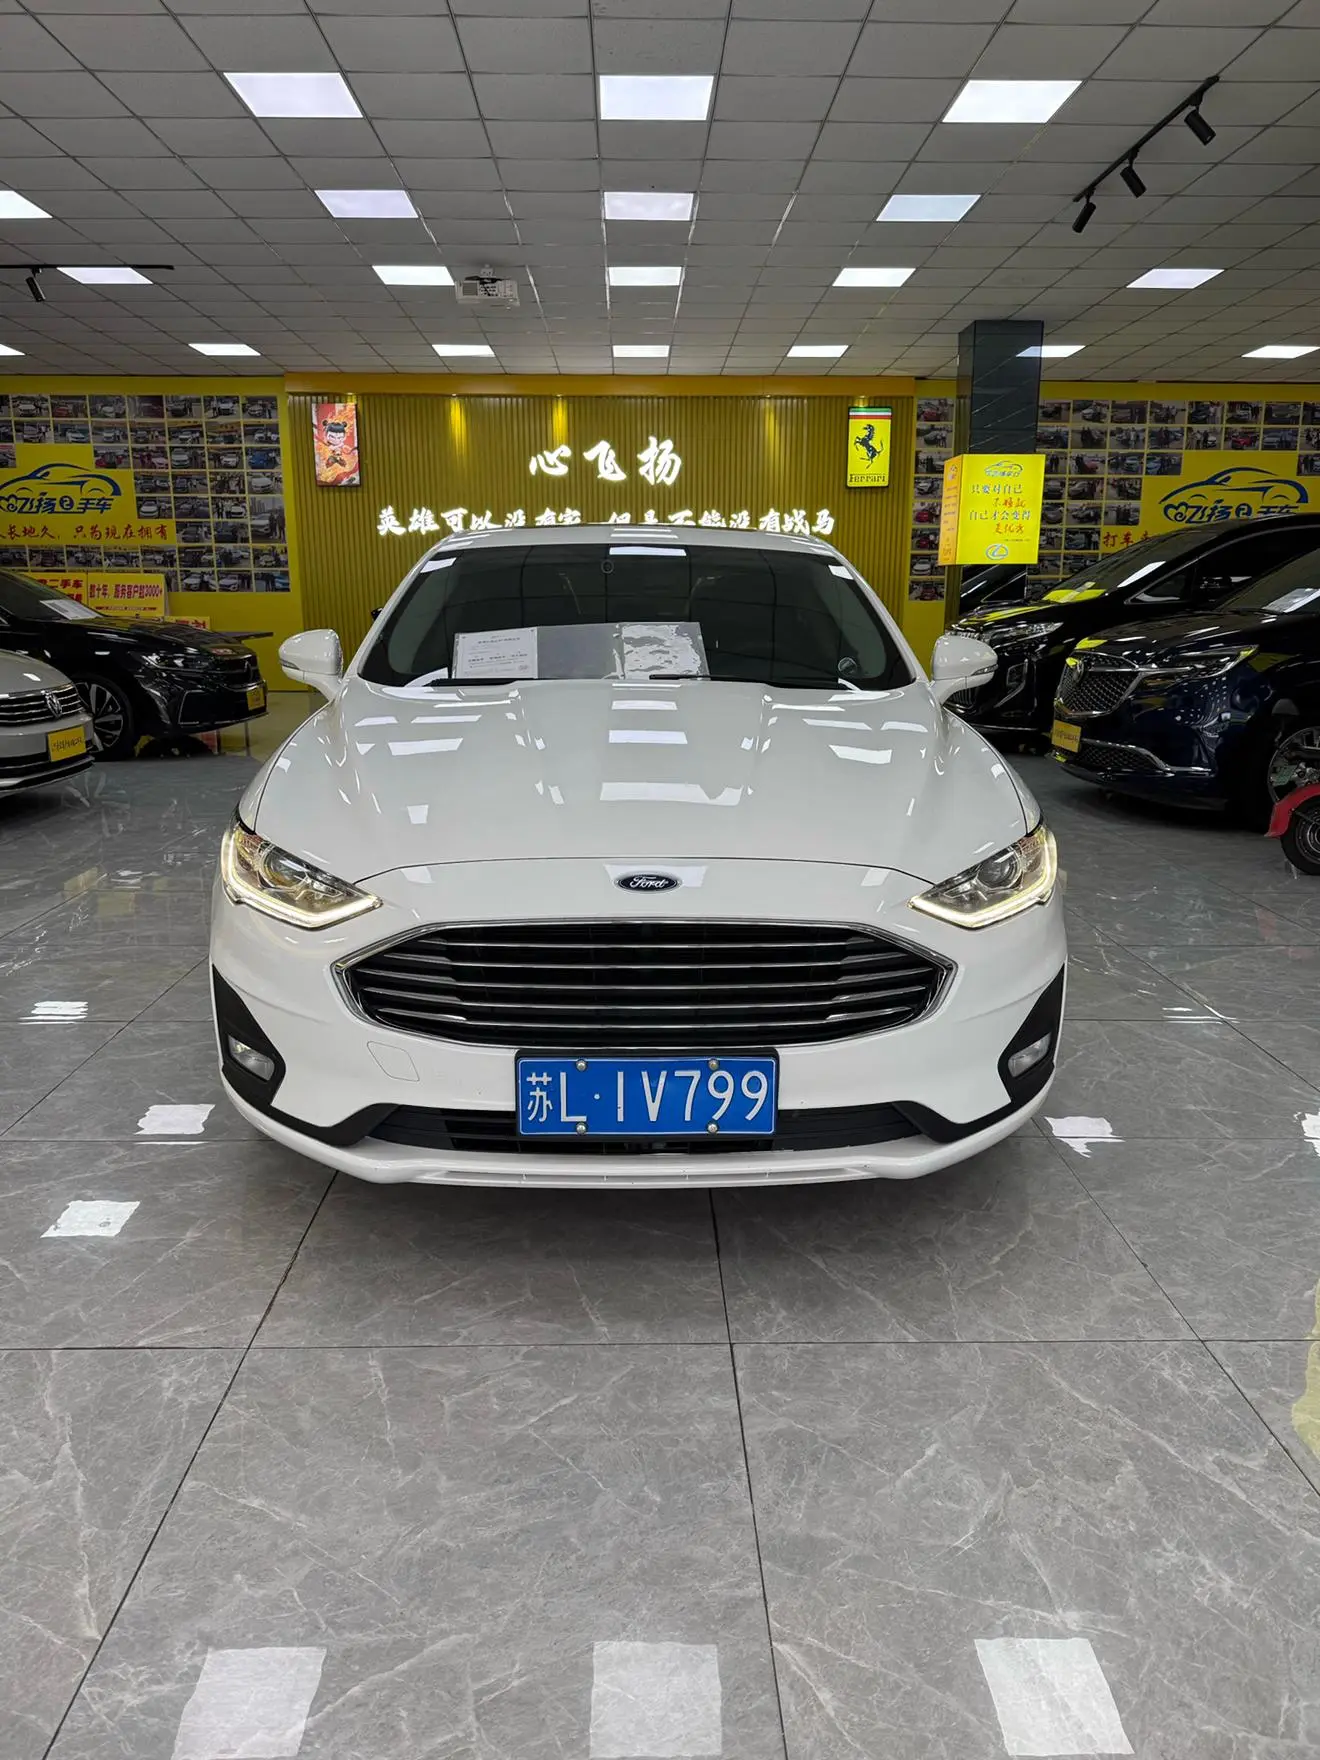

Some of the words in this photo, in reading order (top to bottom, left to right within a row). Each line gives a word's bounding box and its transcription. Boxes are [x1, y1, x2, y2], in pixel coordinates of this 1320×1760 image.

[529, 437, 682, 486] 心飞扬
[850, 472, 886, 483] Ferrari
[629, 876, 669, 888] Ford
